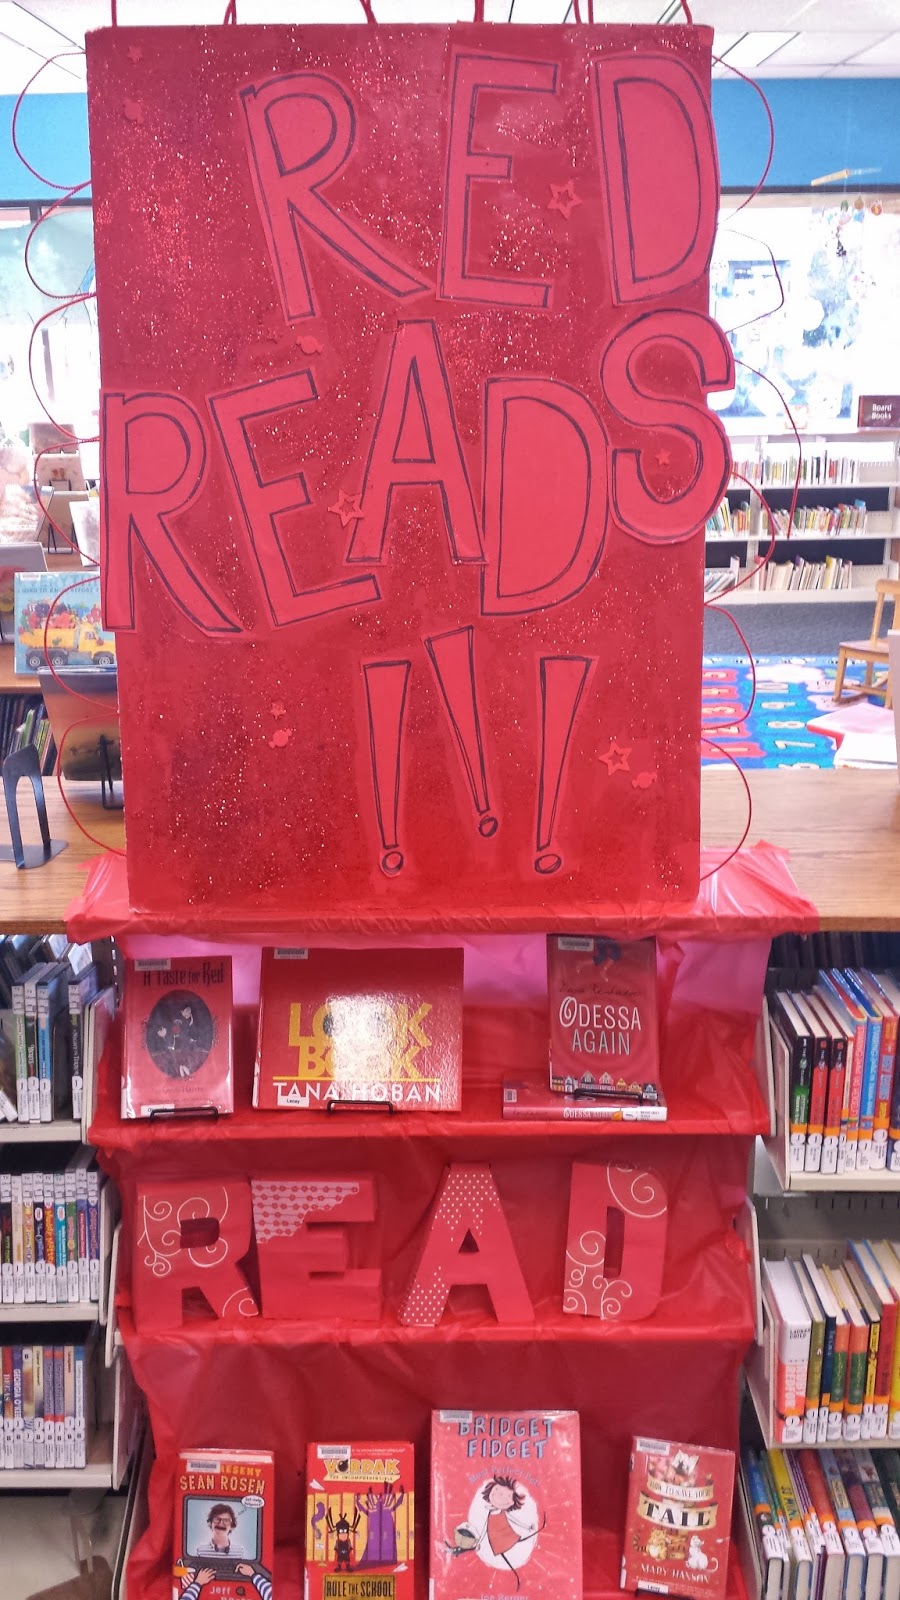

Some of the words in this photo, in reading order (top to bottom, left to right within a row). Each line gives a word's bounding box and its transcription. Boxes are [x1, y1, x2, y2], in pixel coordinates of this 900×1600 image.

[240, 53, 717, 318] RED
[871, 412, 892, 420] Books
[102, 313, 734, 633] READS
[202, 962, 225, 986] Red
[559, 996, 642, 1031] ODESSA
[572, 1029, 630, 1056] AGAIN
[273, 1083, 340, 1101] TANA
[352, 1083, 441, 1103] HOBAN
[134, 1162, 669, 1331] READ
[13, 1369, 21, 1398] GEORGIA
[459, 1416, 556, 1437] BRIDGET
[467, 1438, 548, 1459] FIDGET
[180, 1475, 214, 1490] SEAN
[221, 1476, 265, 1494] ROSEN
[643, 1501, 710, 1527] TAIL
[641, 1563, 667, 1577] MARY
[672, 1569, 709, 1584] HANSON
[210, 1586, 231, 1595] Jeff
[326, 1581, 347, 1597] RULE
[348, 1583, 359, 1595] THE
[360, 1581, 393, 1598] SCHOOL
